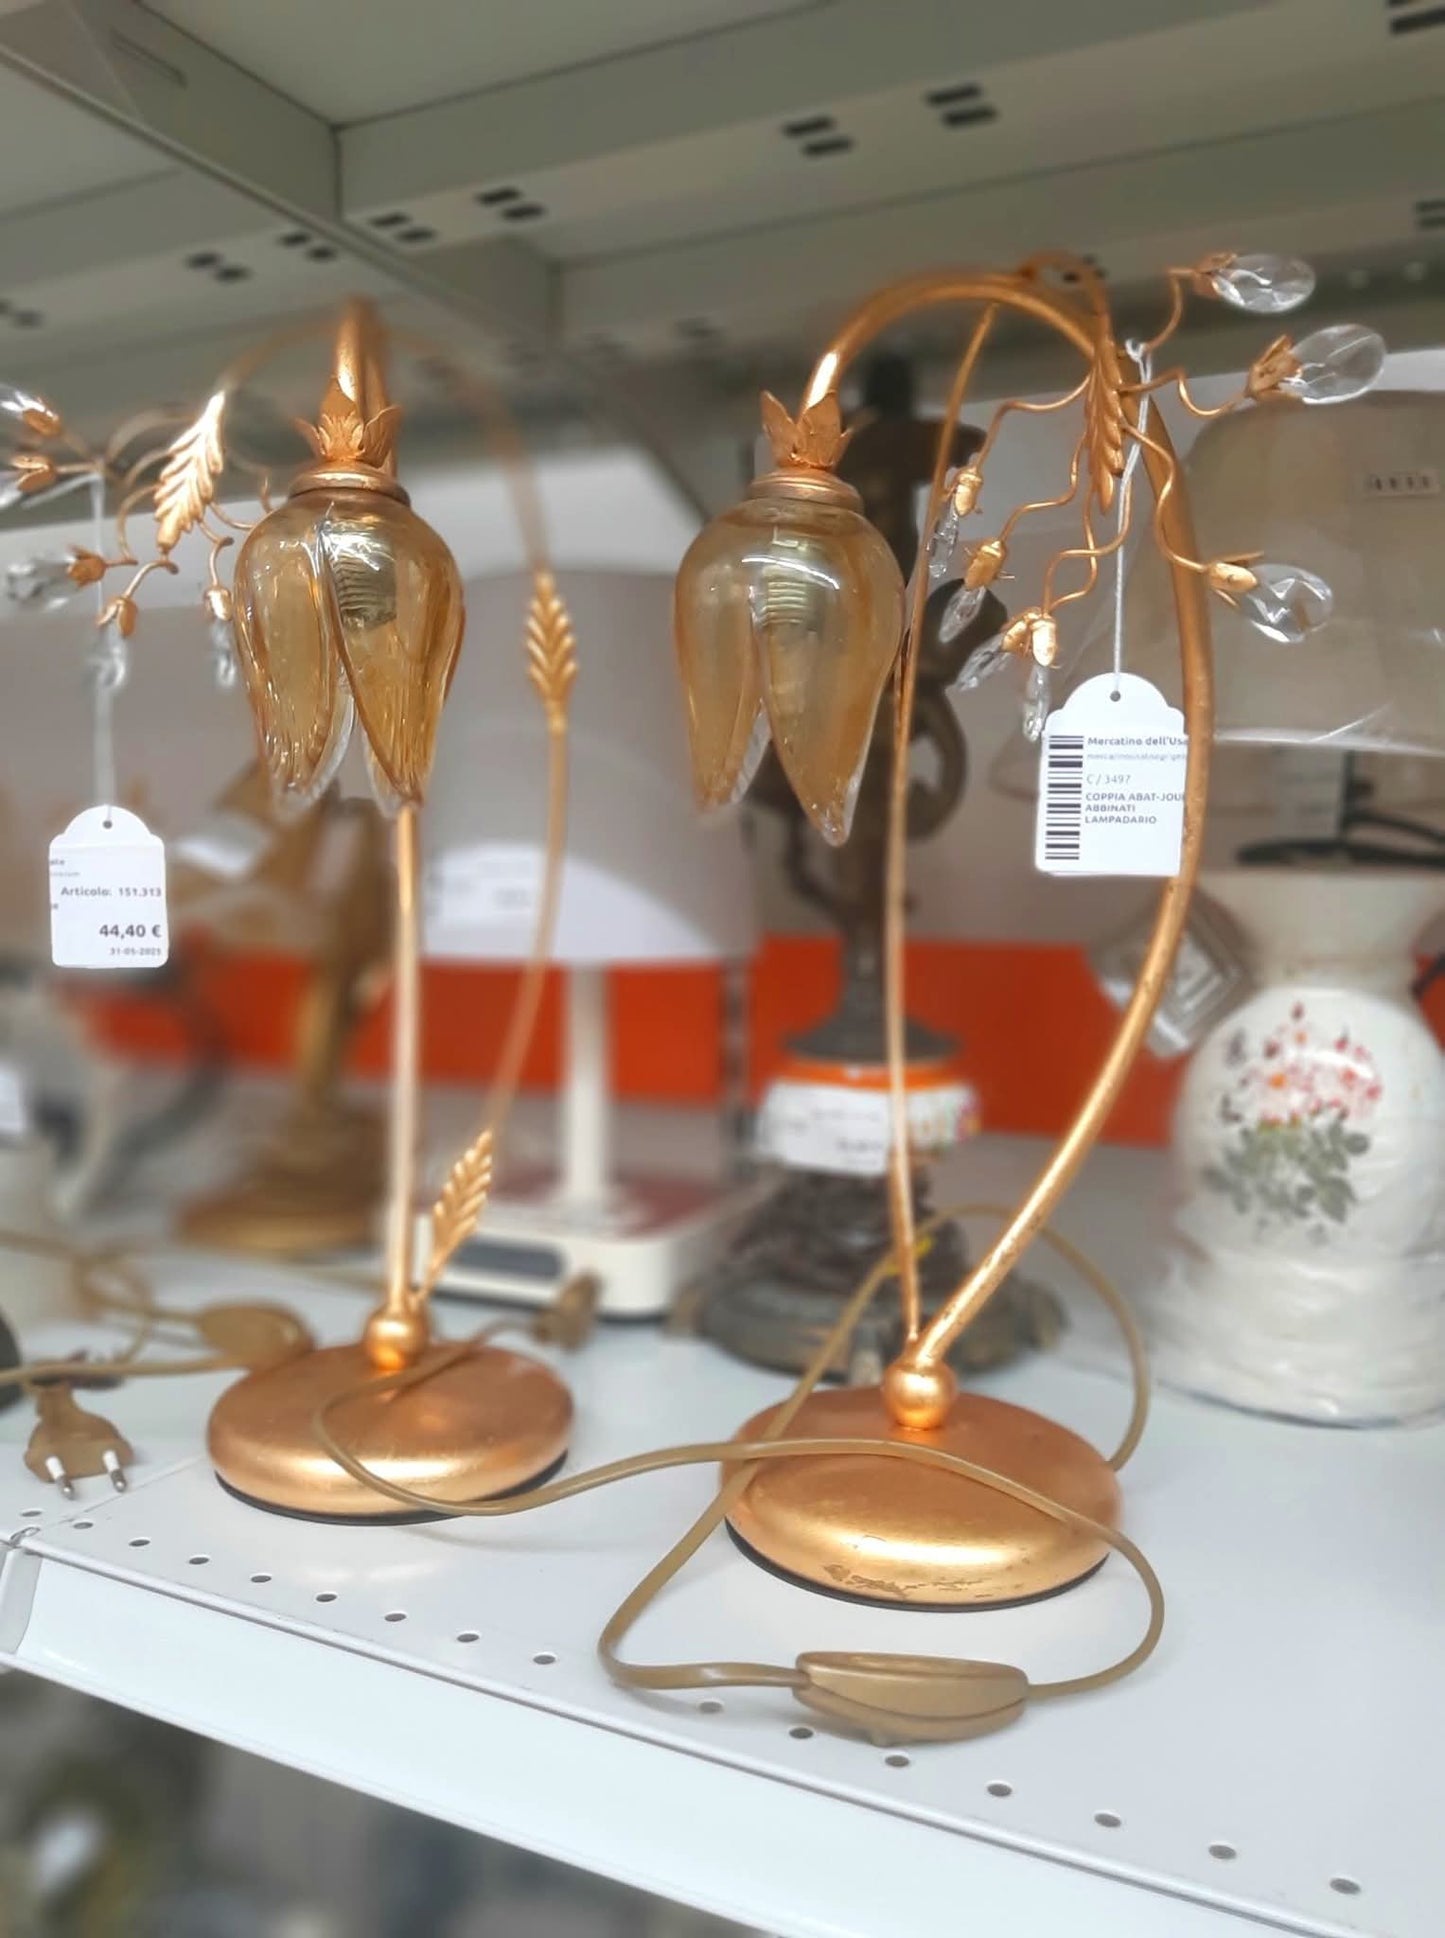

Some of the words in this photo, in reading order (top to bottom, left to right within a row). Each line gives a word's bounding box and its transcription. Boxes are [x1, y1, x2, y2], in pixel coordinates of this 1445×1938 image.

[1087, 736, 1143, 746] Mercatino
[1085, 793, 1126, 802] COPPIA
[1085, 804, 1136, 812] ABBINATI
[1085, 815, 1157, 824] LAMPADARIO
[60, 886, 112, 897] Articolo:
[99, 924, 146, 939] 44,40
[151, 924, 162, 938] €
